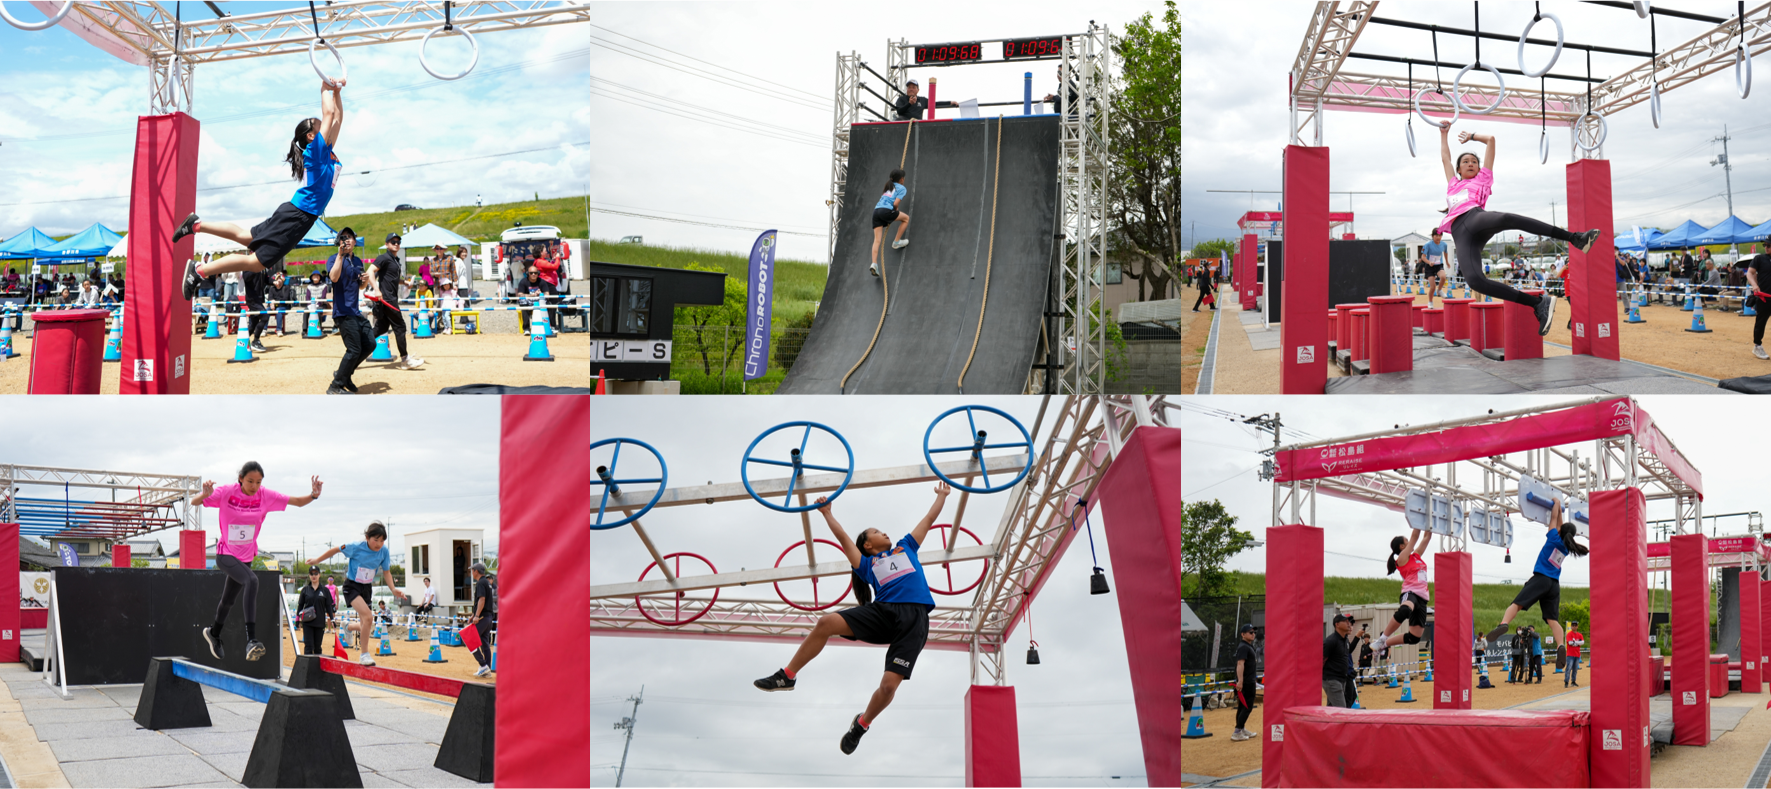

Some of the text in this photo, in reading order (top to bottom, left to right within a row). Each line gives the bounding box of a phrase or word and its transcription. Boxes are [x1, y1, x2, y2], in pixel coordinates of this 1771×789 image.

[917, 44, 979, 62] 01:09:68
[590, 341, 666, 359] ピーS
[1611, 417, 1630, 427] JOS
[239, 530, 246, 540] 5
[889, 561, 898, 571] 4
